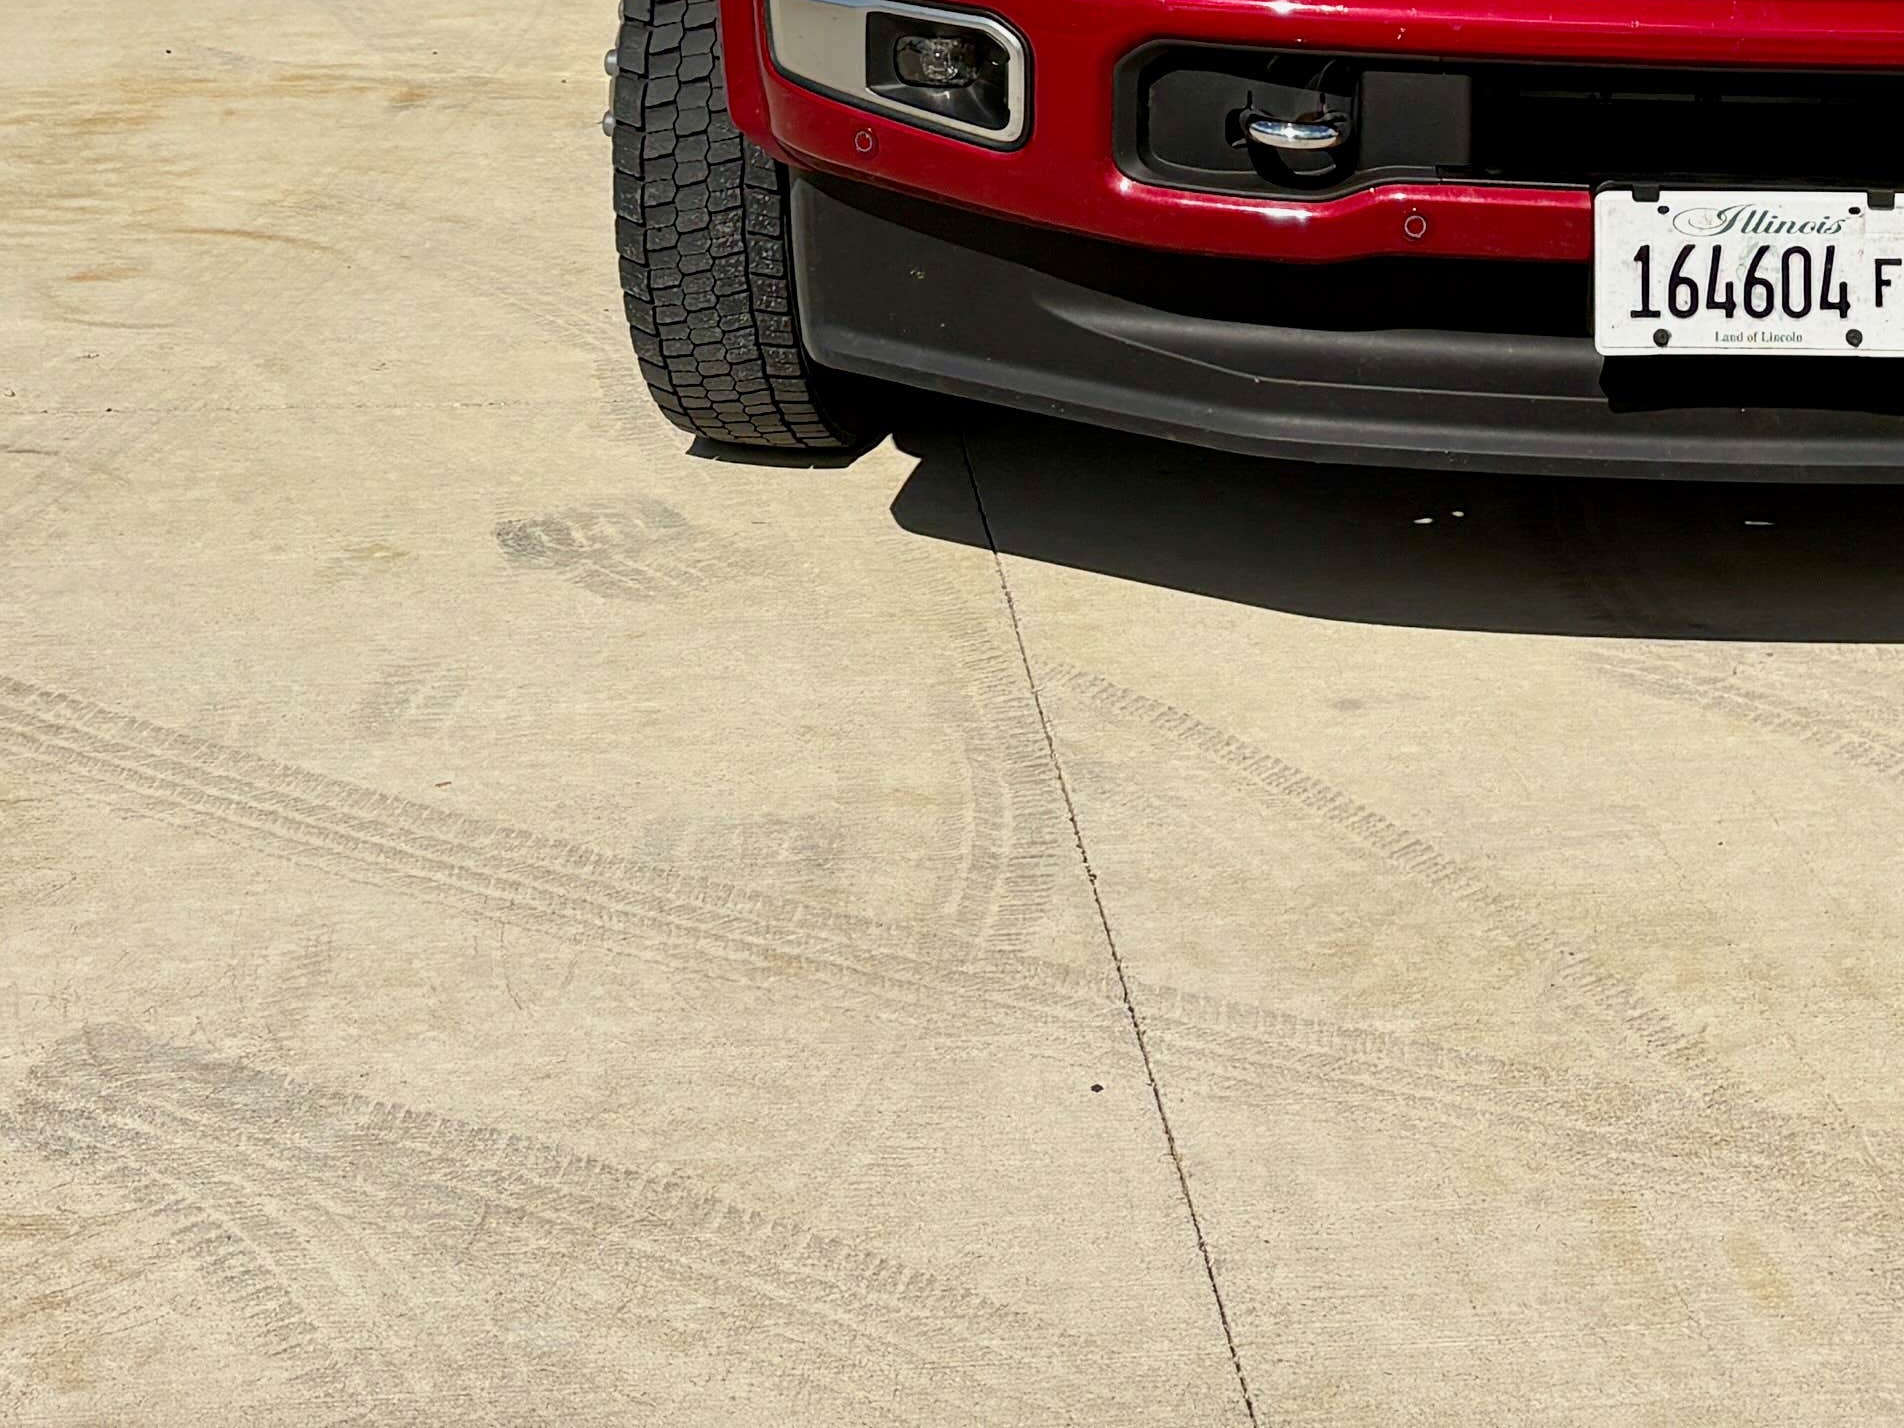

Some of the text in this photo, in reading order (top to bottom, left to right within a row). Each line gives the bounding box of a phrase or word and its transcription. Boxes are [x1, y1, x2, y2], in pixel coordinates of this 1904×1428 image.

[1672, 203, 1851, 237] Illinois
[1630, 244, 1903, 319] 164604 F
[1715, 331, 1803, 343] Land of Lincoln
